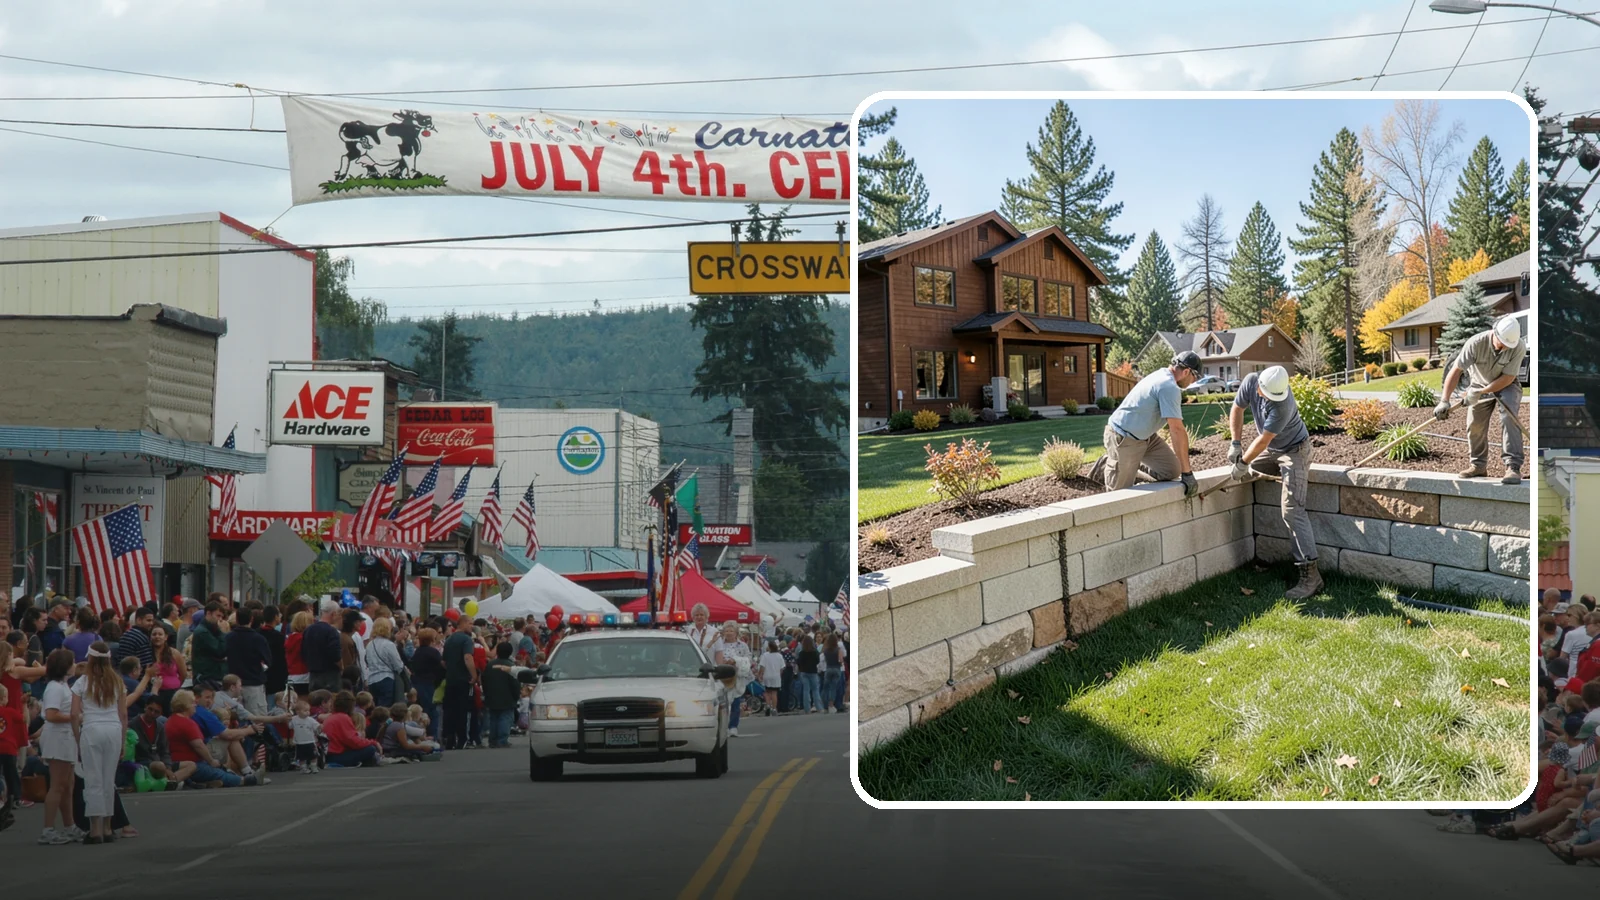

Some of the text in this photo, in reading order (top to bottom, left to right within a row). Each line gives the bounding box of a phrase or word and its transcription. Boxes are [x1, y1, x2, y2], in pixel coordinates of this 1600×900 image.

[481, 141, 604, 192] JULY
[632, 149, 746, 198] 4th.
[282, 380, 373, 420] ACE
[405, 409, 485, 421] CEDAR LOG
[283, 420, 371, 437] Hardware
[416, 428, 477, 447] Coca-Cola
[83, 484, 155, 496] St. Vincent de Paul
[688, 526, 741, 535] CRNATION
[699, 535, 730, 543] GLASS
